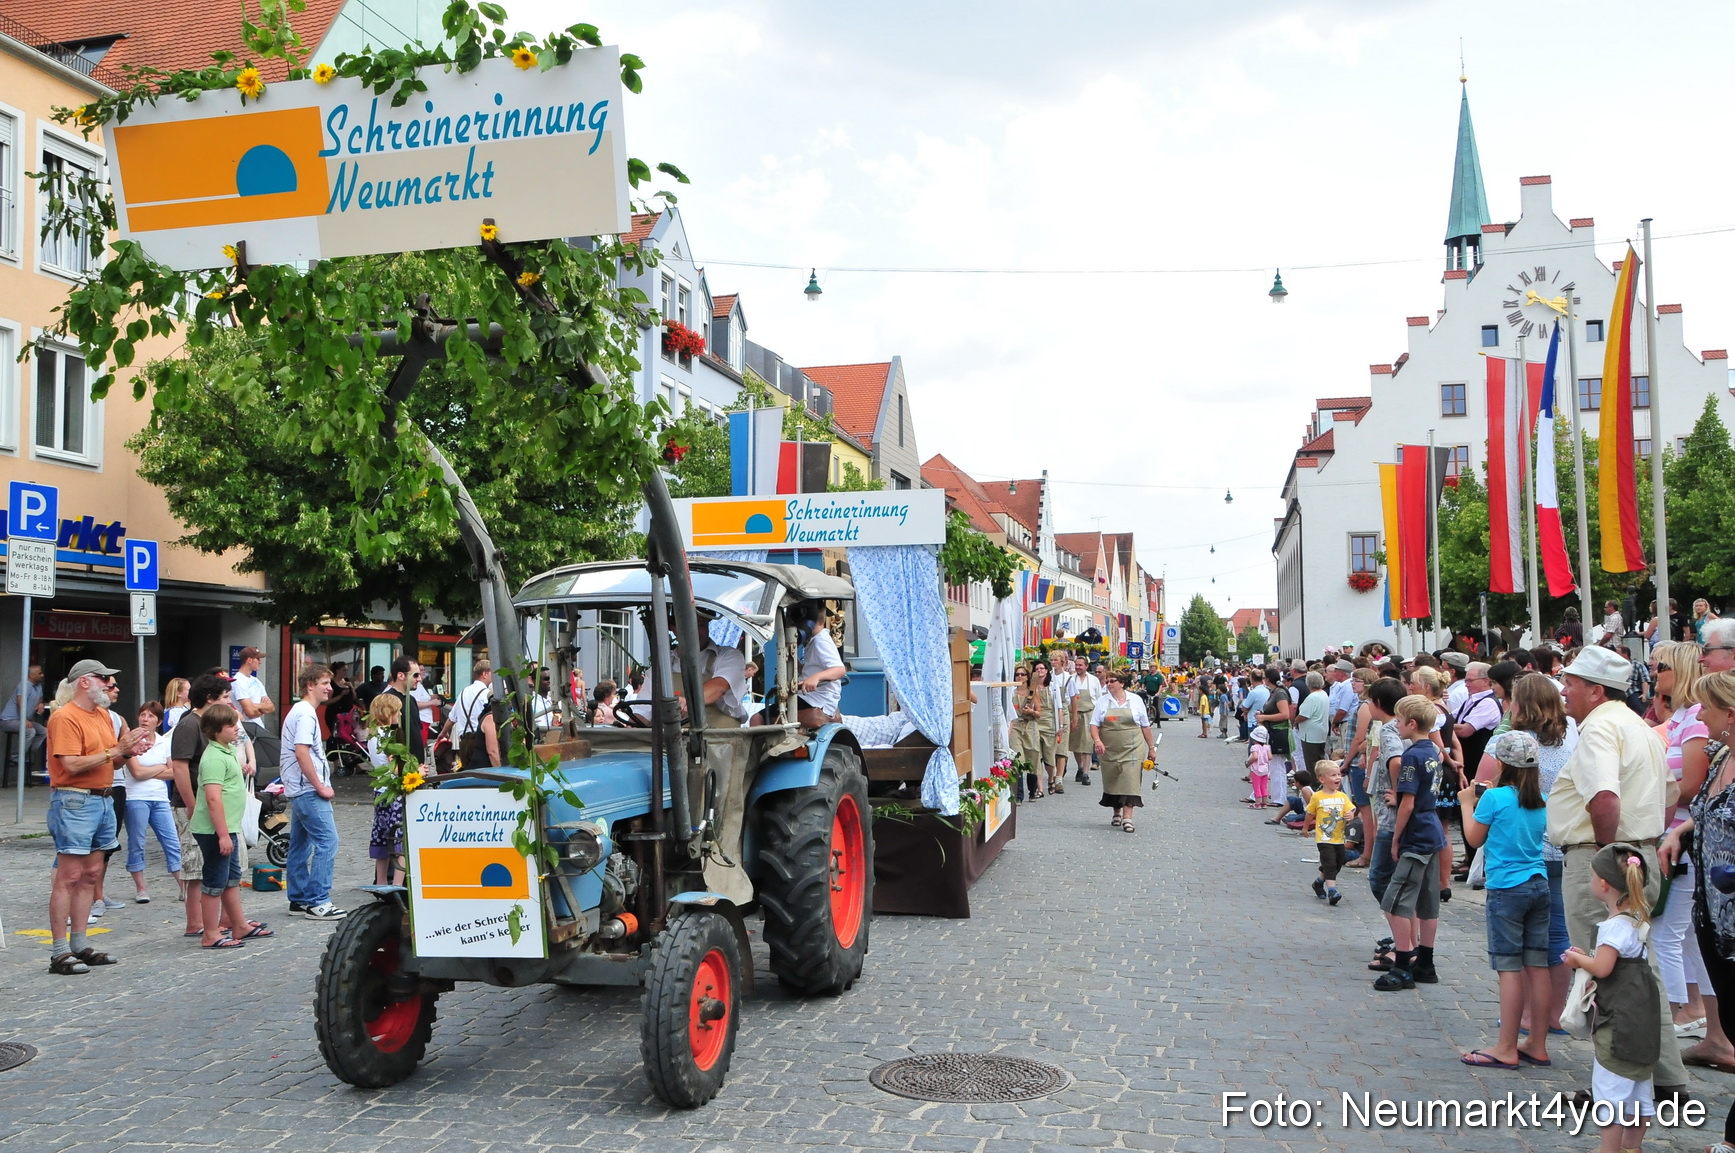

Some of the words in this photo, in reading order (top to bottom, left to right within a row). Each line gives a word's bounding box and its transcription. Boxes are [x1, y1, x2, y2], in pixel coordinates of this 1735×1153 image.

[318, 92, 609, 157] Schreinerinnung
[325, 145, 495, 214] Neumarkt
[20, 489, 47, 531] P
[783, 498, 909, 526] Schreinerinnung
[784, 519, 860, 543] Neumarkt
[11, 550, 52, 563] Parkschein
[18, 544, 31, 552] nur
[34, 545, 46, 554] mit
[15, 561, 49, 573] werktags
[132, 546, 151, 584] P
[10, 580, 19, 589] Sa
[48, 615, 87, 637] Super
[438, 822, 504, 843] Neumarkt
[454, 922, 472, 933] der
[474, 912, 528, 929] Schreir,
[460, 930, 496, 945] kann's
[497, 922, 531, 938] keer
